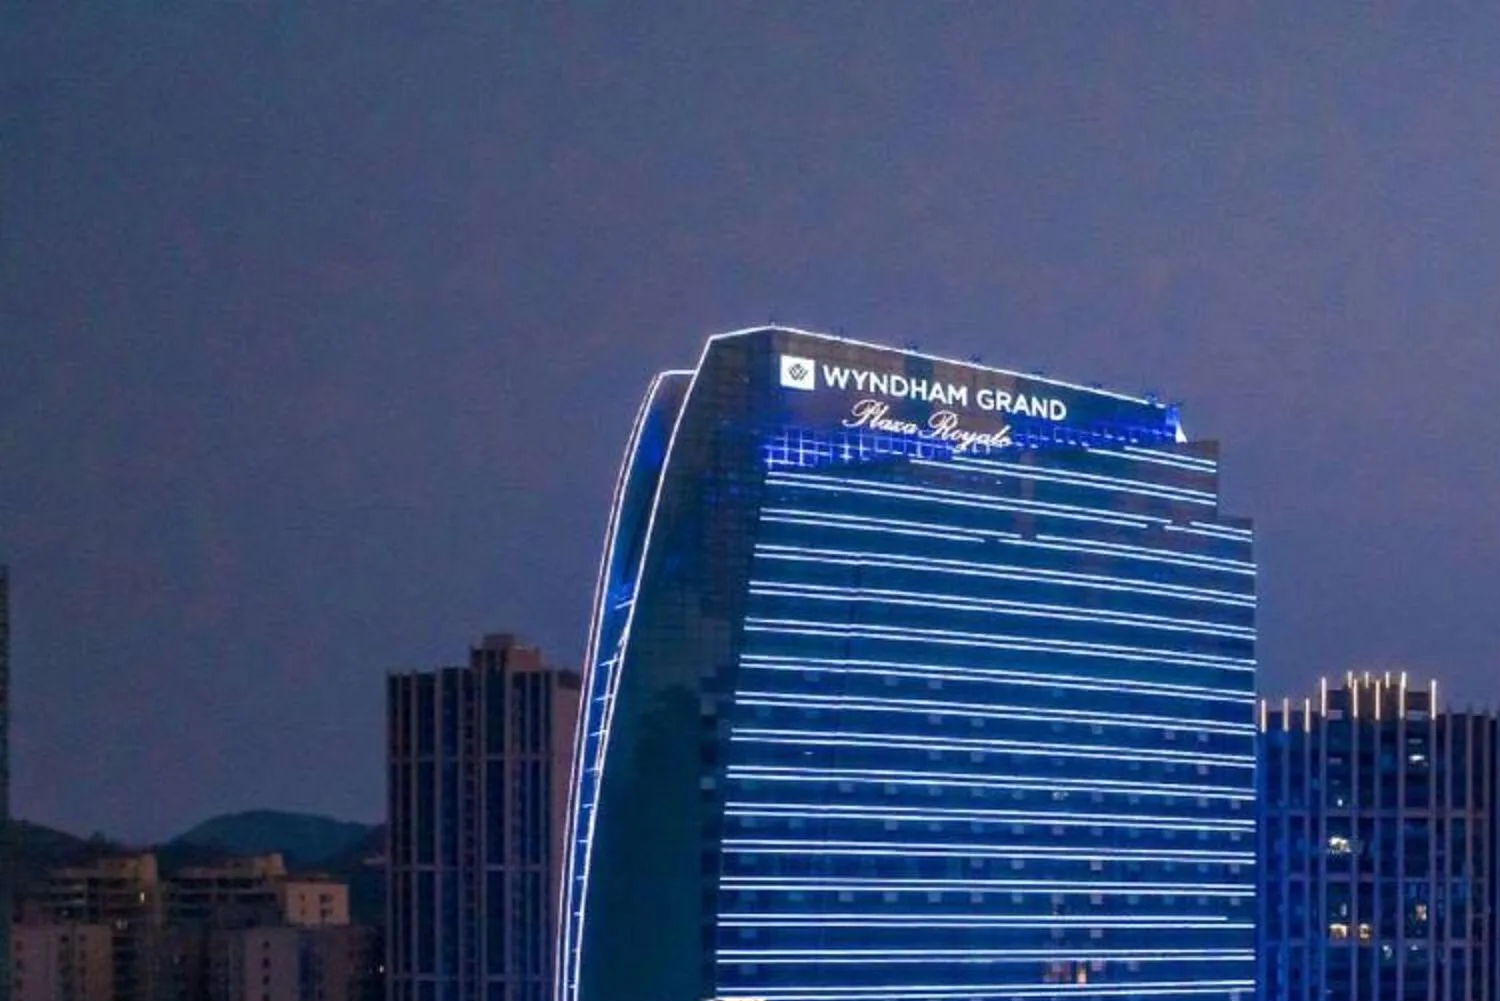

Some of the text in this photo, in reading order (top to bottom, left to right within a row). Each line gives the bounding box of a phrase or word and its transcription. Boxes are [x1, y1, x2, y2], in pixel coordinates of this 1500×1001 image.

[822, 365, 1067, 421] WYNDHAM GRAND
[842, 399, 1013, 452] Plaza Royale
